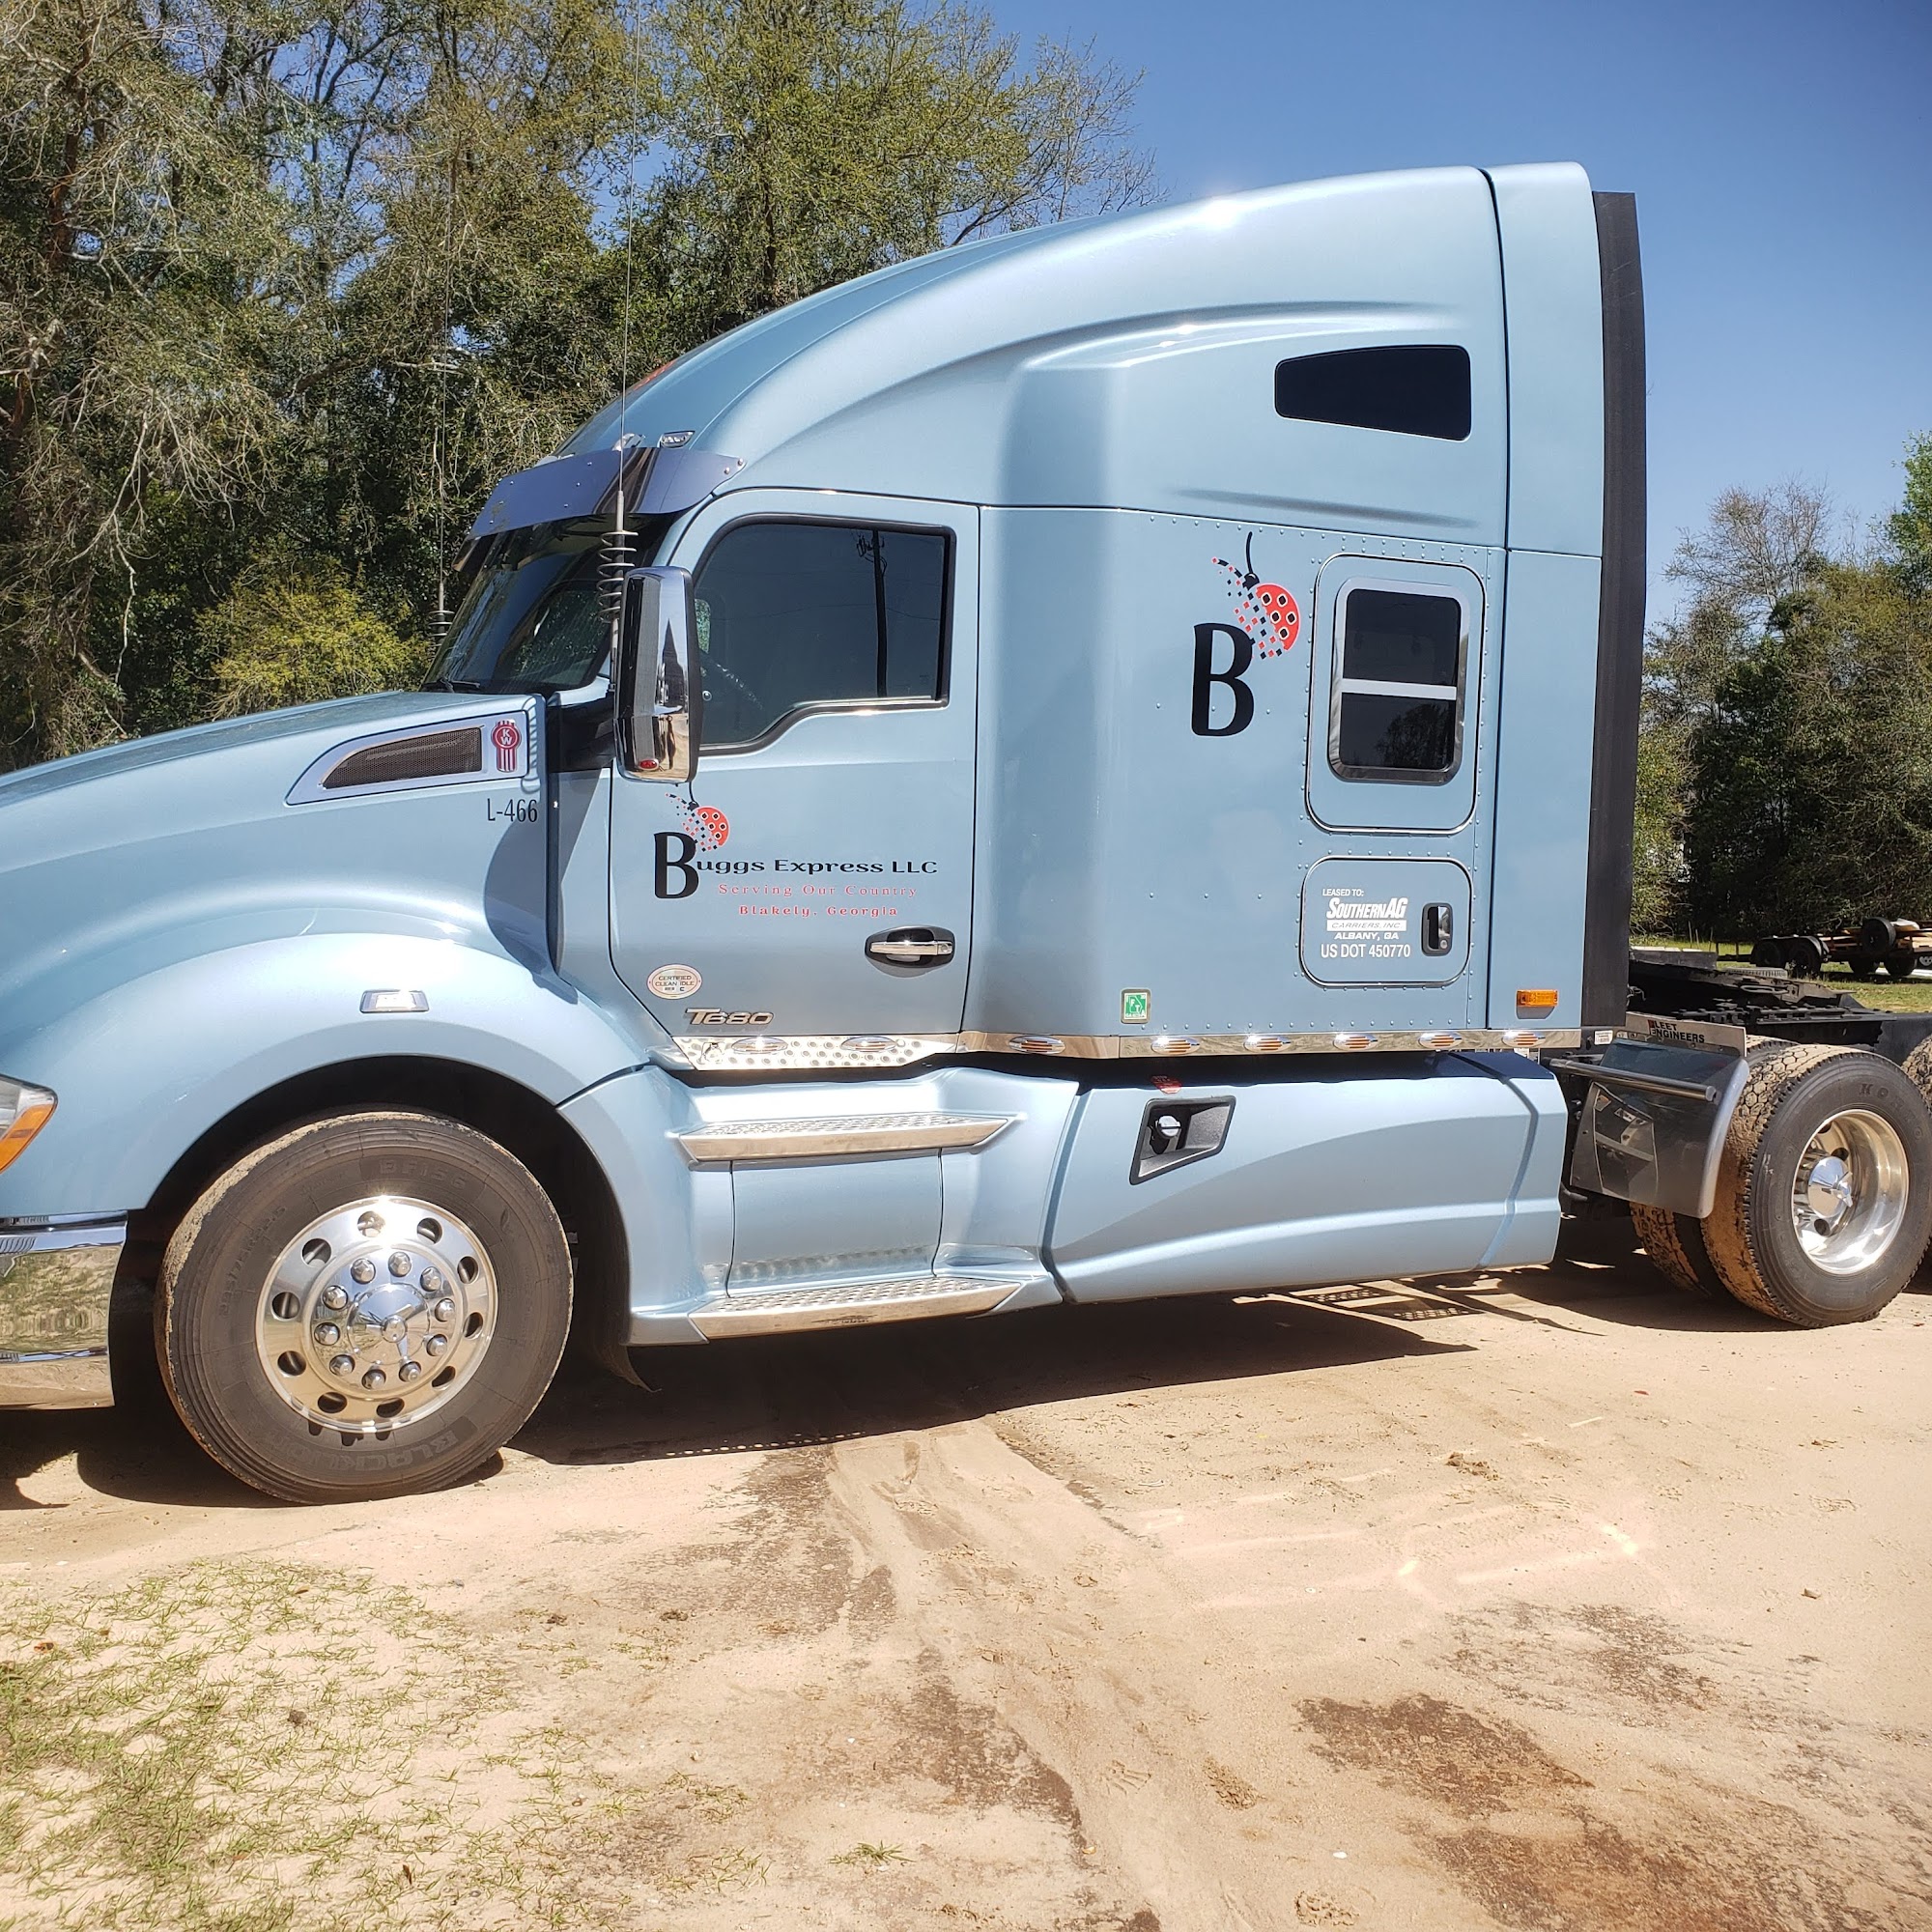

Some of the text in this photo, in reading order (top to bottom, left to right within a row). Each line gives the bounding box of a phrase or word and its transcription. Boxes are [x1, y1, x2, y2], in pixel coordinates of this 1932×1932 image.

[1191, 622, 1255, 737] B
[487, 798, 538, 823] L-466
[653, 831, 938, 899] Buggs Express LLC
[718, 883, 918, 897] Serving Our Country
[827, 906, 897, 918] Georgia
[1334, 931, 1380, 941] ALBANY,
[1321, 944, 1410, 958] US DOT 450770
[685, 1008, 774, 1026] T680
[1650, 1028, 1705, 1043] ENGINEERS
